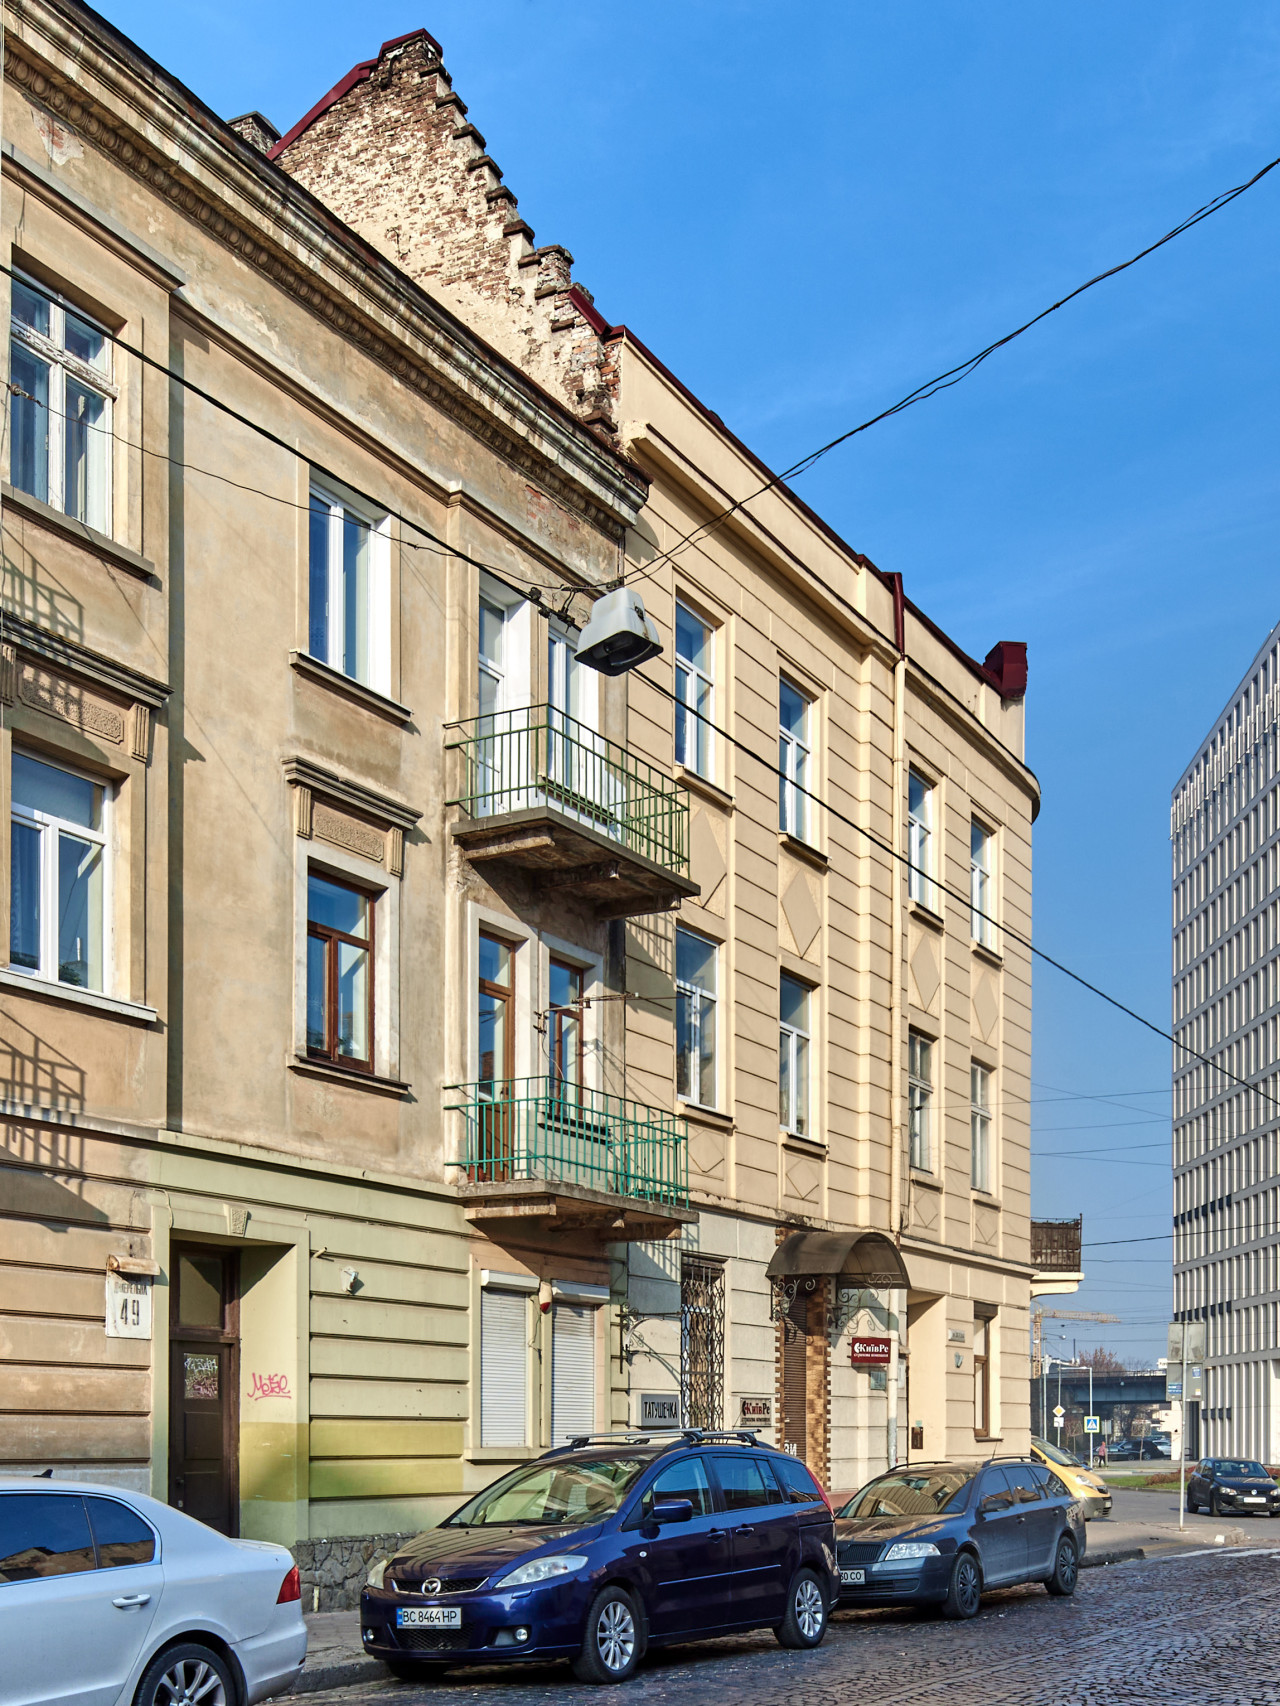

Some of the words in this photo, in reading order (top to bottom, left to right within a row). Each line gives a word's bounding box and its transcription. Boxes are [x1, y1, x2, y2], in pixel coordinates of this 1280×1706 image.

[120, 1298, 140, 1326] 49
[644, 1401, 678, 1419] ТАТУШЕЧКА
[850, 1572, 861, 1580] CO
[403, 1611, 416, 1622] BC
[418, 1611, 440, 1622] 8464
[443, 1611, 457, 1622] HP
